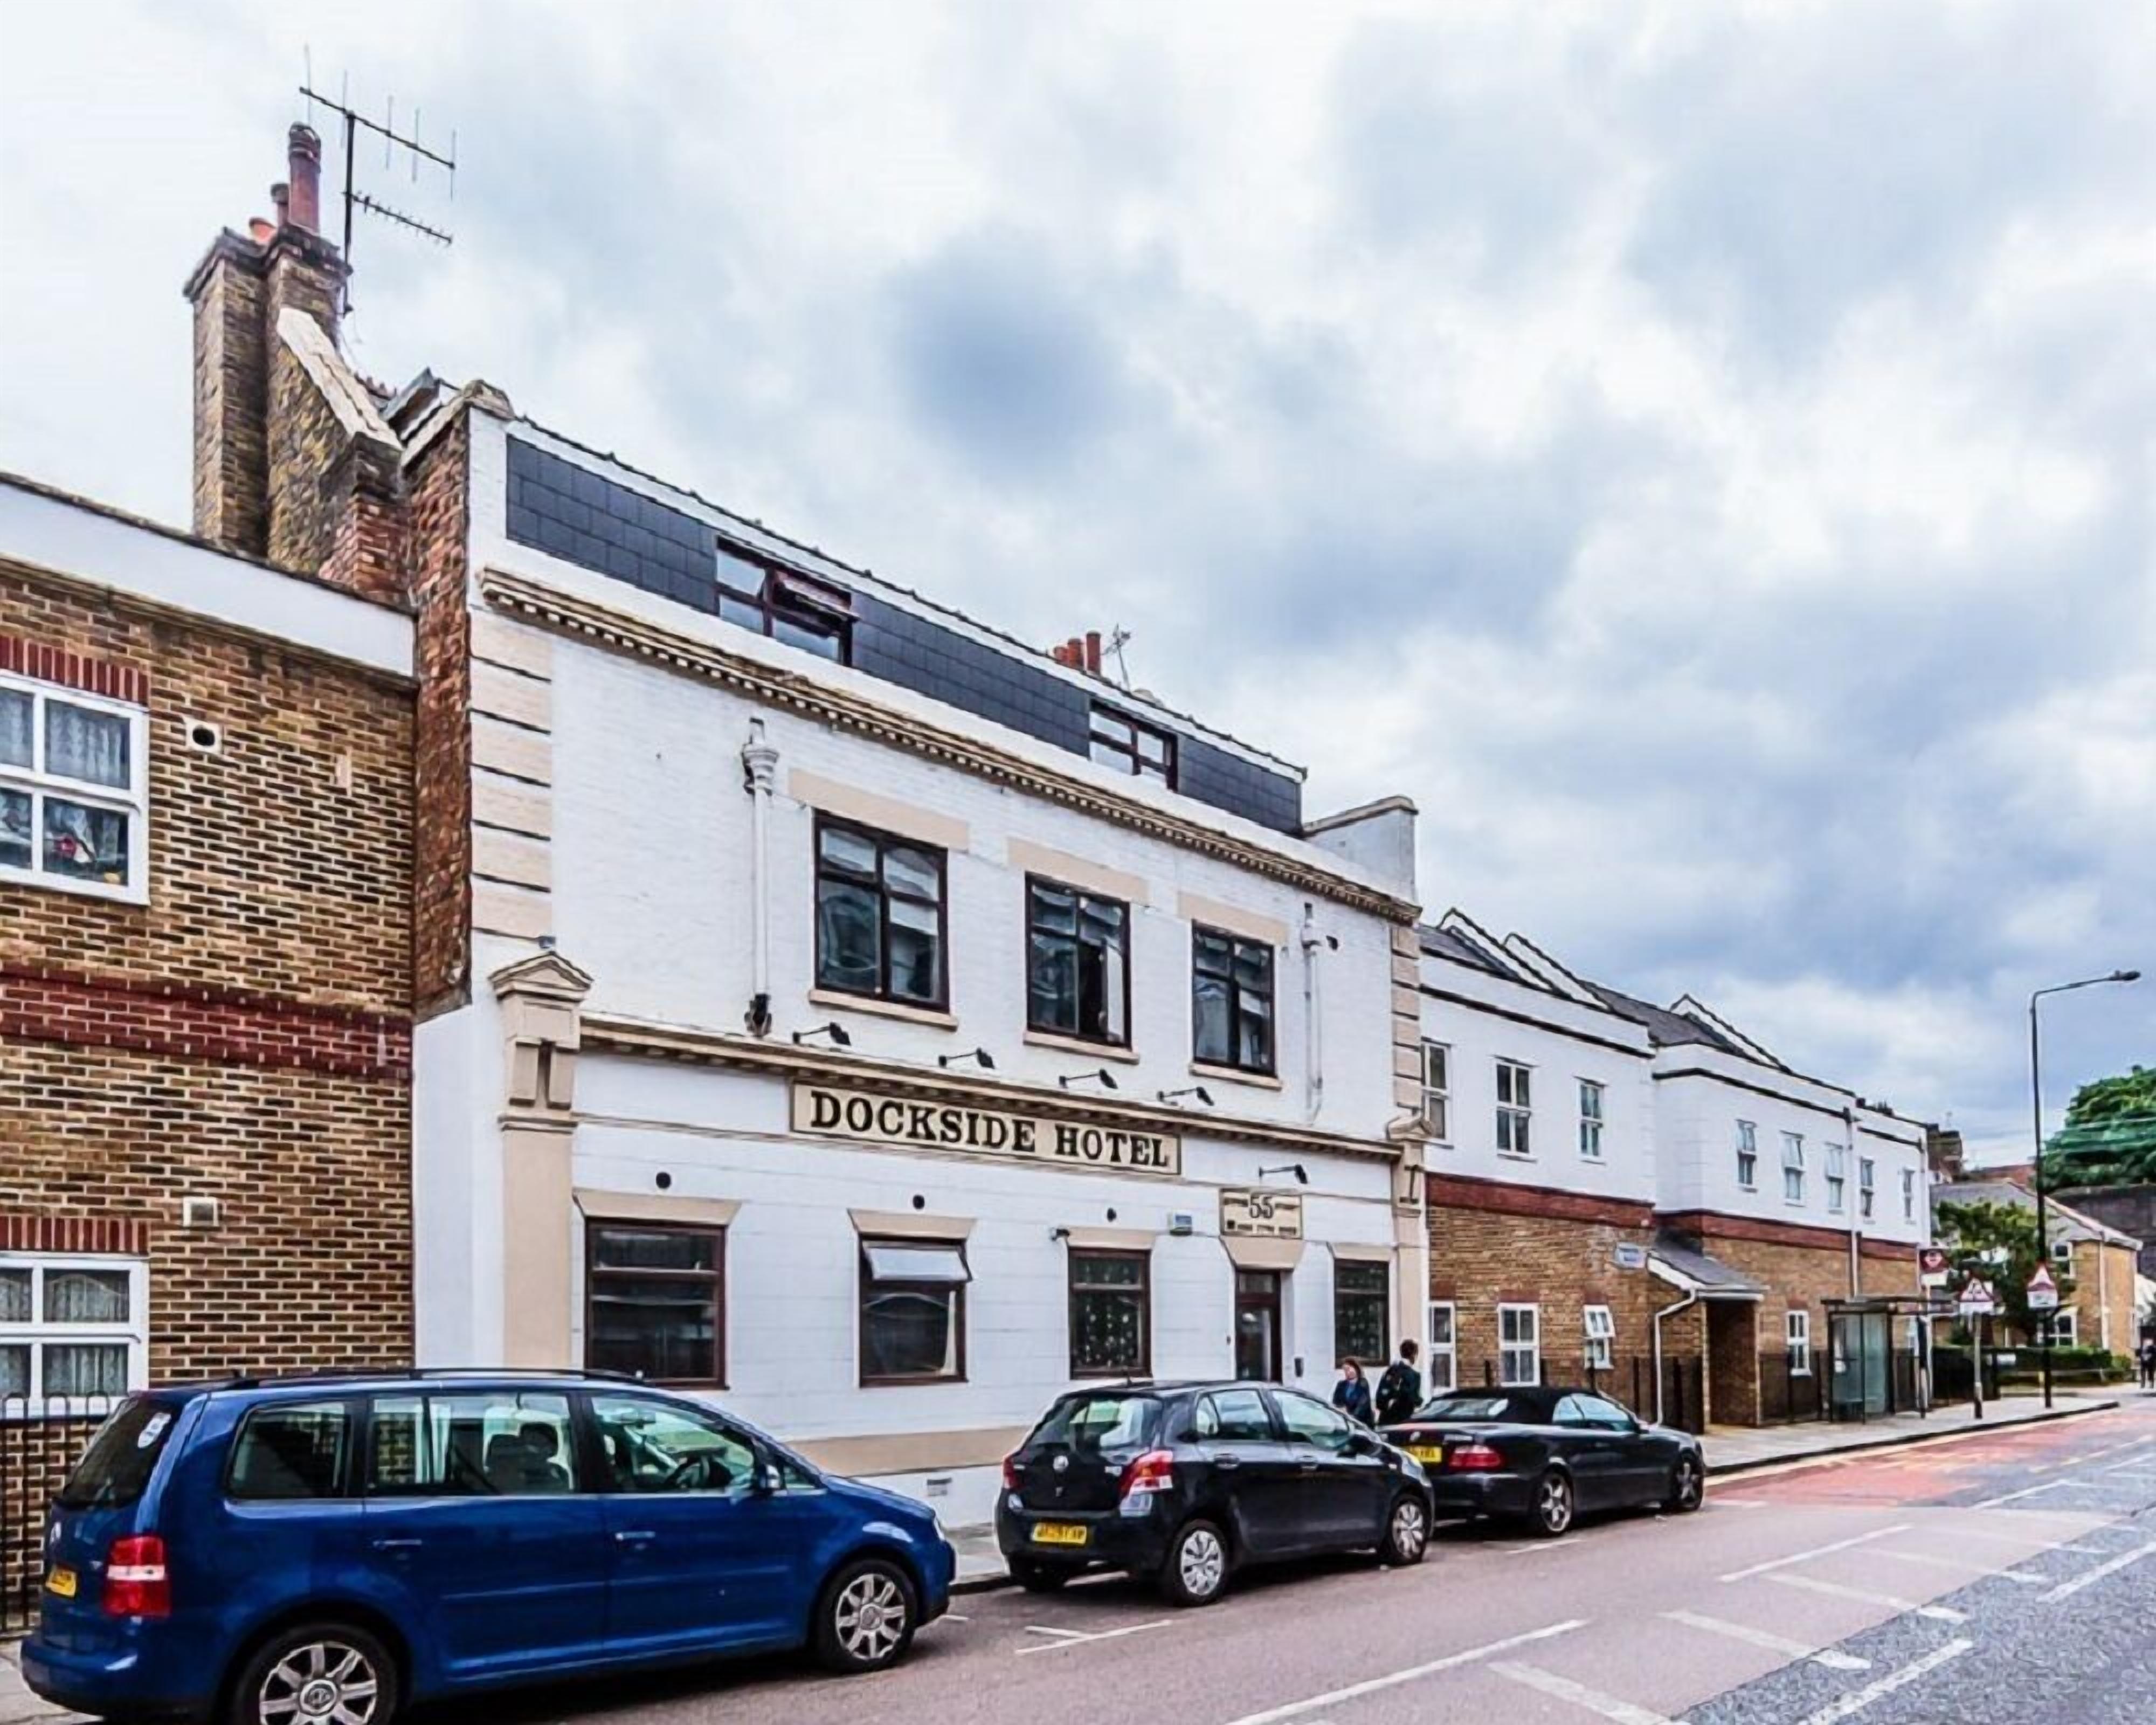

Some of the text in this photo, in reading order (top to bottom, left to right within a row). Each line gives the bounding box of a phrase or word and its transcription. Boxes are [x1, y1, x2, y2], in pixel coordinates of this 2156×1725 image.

[811, 1091, 1170, 1167] DOCKSIDE HOTEL
[1249, 1194, 1274, 1219] 55
